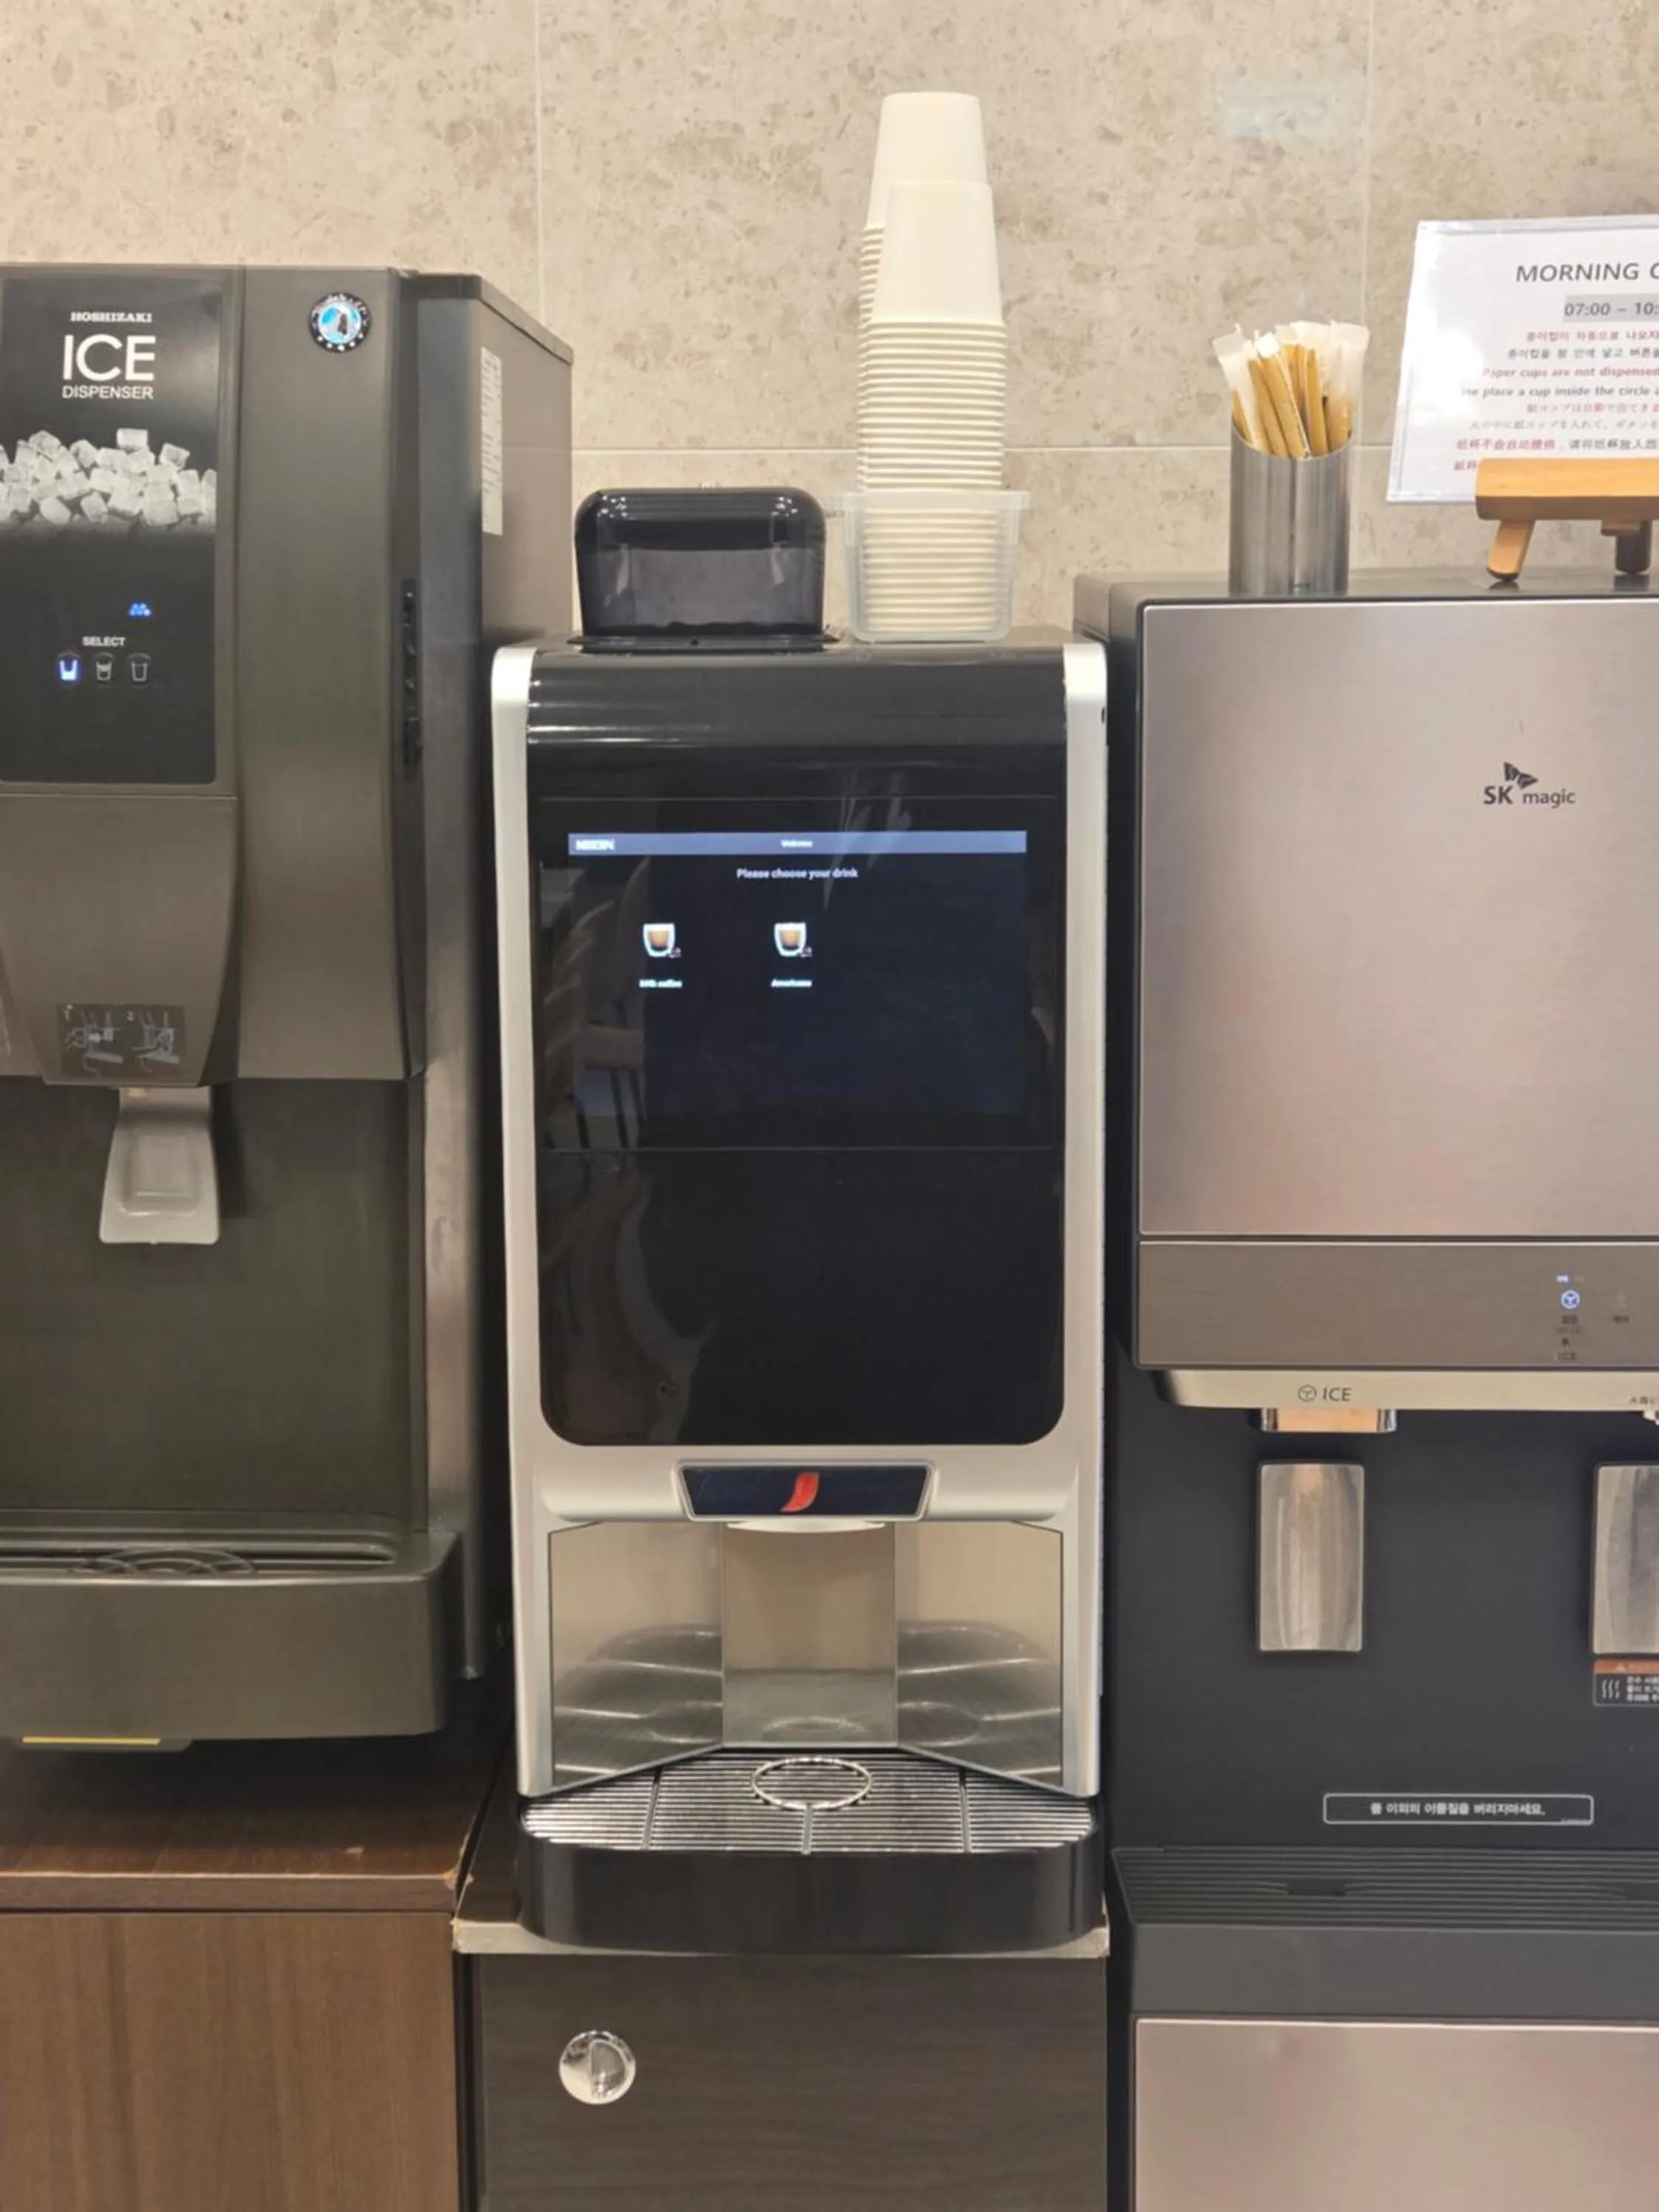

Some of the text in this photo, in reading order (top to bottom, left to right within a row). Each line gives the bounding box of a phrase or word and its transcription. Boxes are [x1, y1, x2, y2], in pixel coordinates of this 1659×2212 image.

[1516, 262, 1640, 282] MORNING
[70, 311, 153, 323] HOSHIZAKI
[1564, 302, 1611, 317] 07:00
[63, 333, 156, 381] ICE
[1520, 369, 1548, 379] cups
[1552, 369, 1571, 377] are
[1575, 367, 1596, 377] not
[62, 385, 154, 400] DISPENSER
[1483, 386, 1514, 399] place
[1528, 389, 1551, 398] cup
[1555, 386, 1590, 397] inside
[1596, 386, 1615, 396] the
[1619, 386, 1651, 396] circle
[83, 636, 126, 647] SELECT
[1484, 785, 1576, 808] SK magic
[737, 867, 859, 880] Please choose your drink
[1323, 1387, 1353, 1402] ICE
